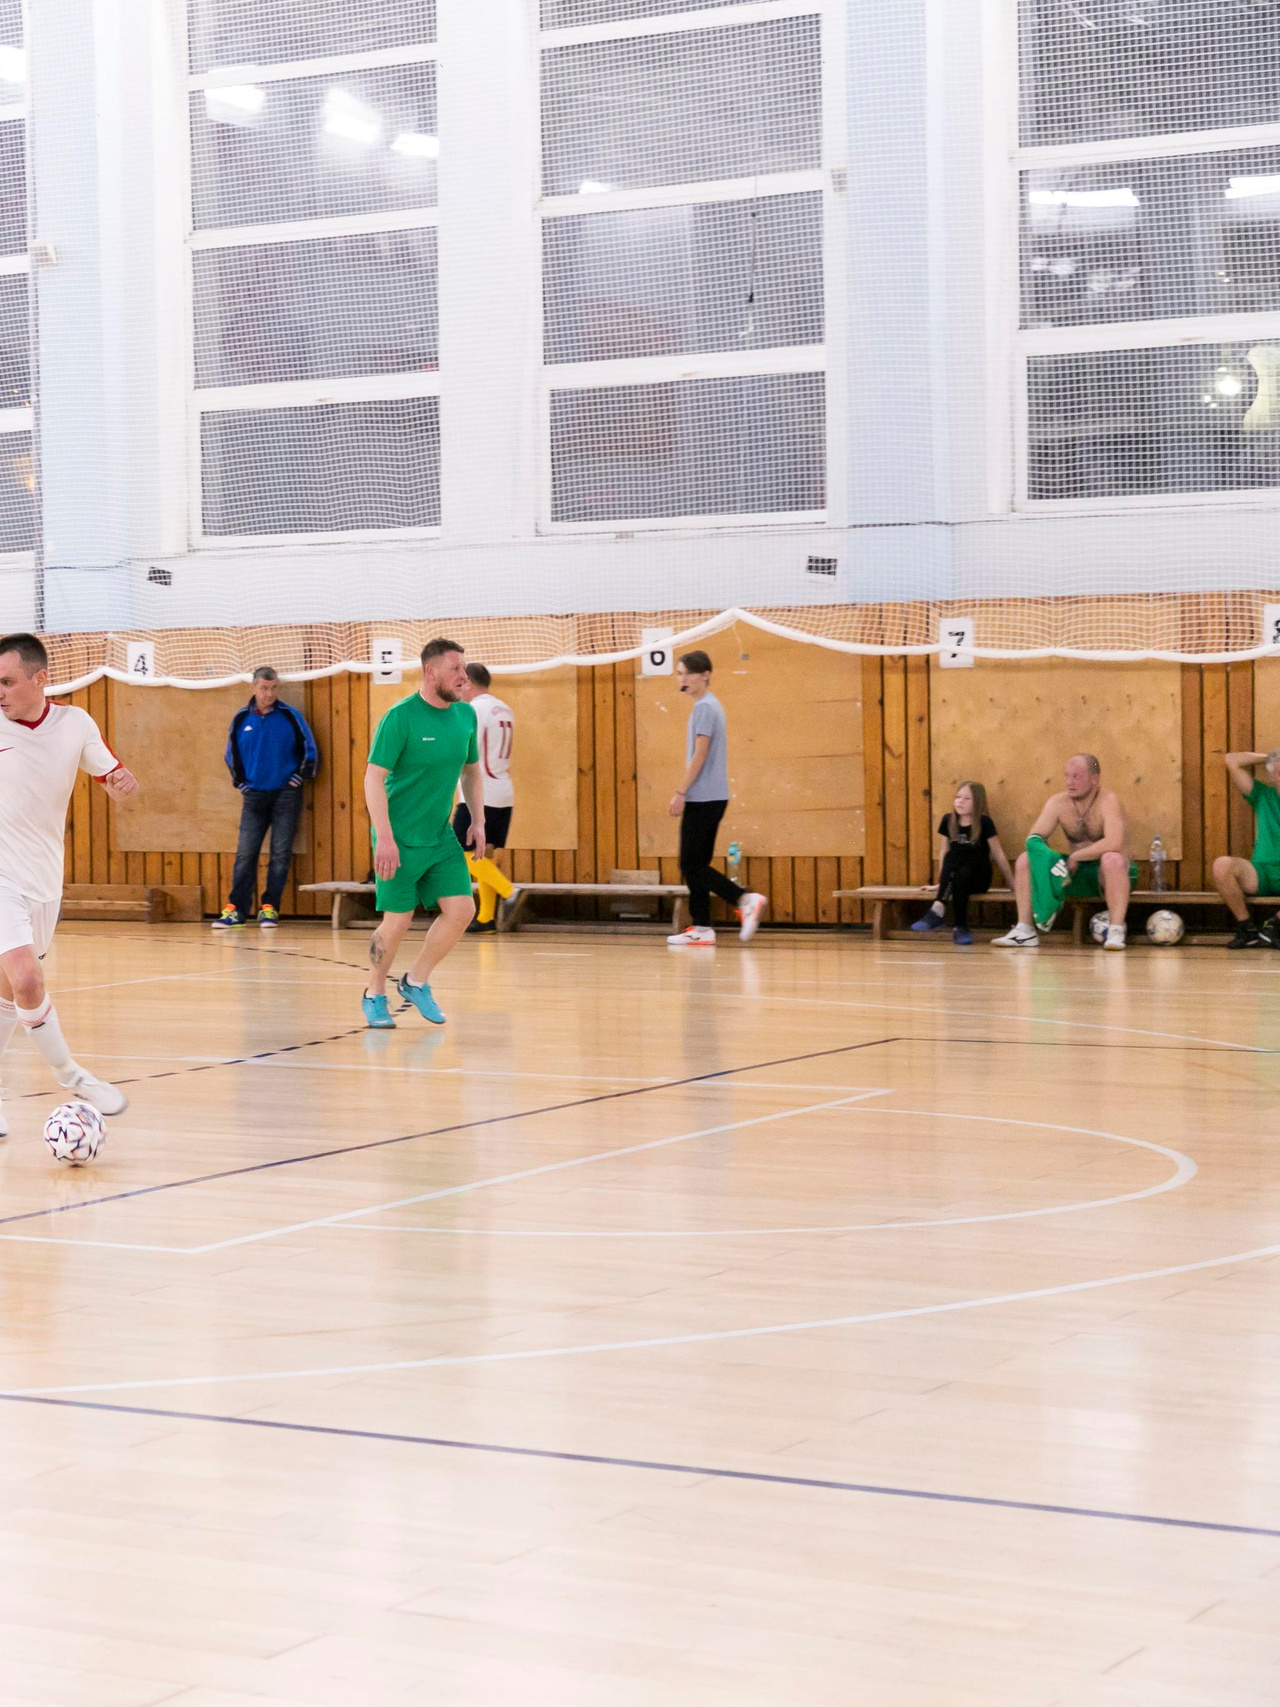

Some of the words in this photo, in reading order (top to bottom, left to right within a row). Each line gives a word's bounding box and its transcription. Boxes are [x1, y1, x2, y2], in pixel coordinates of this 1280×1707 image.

[948, 631, 965, 659] 7
[133, 653, 148, 676] 4
[499, 720, 513, 760] 11
